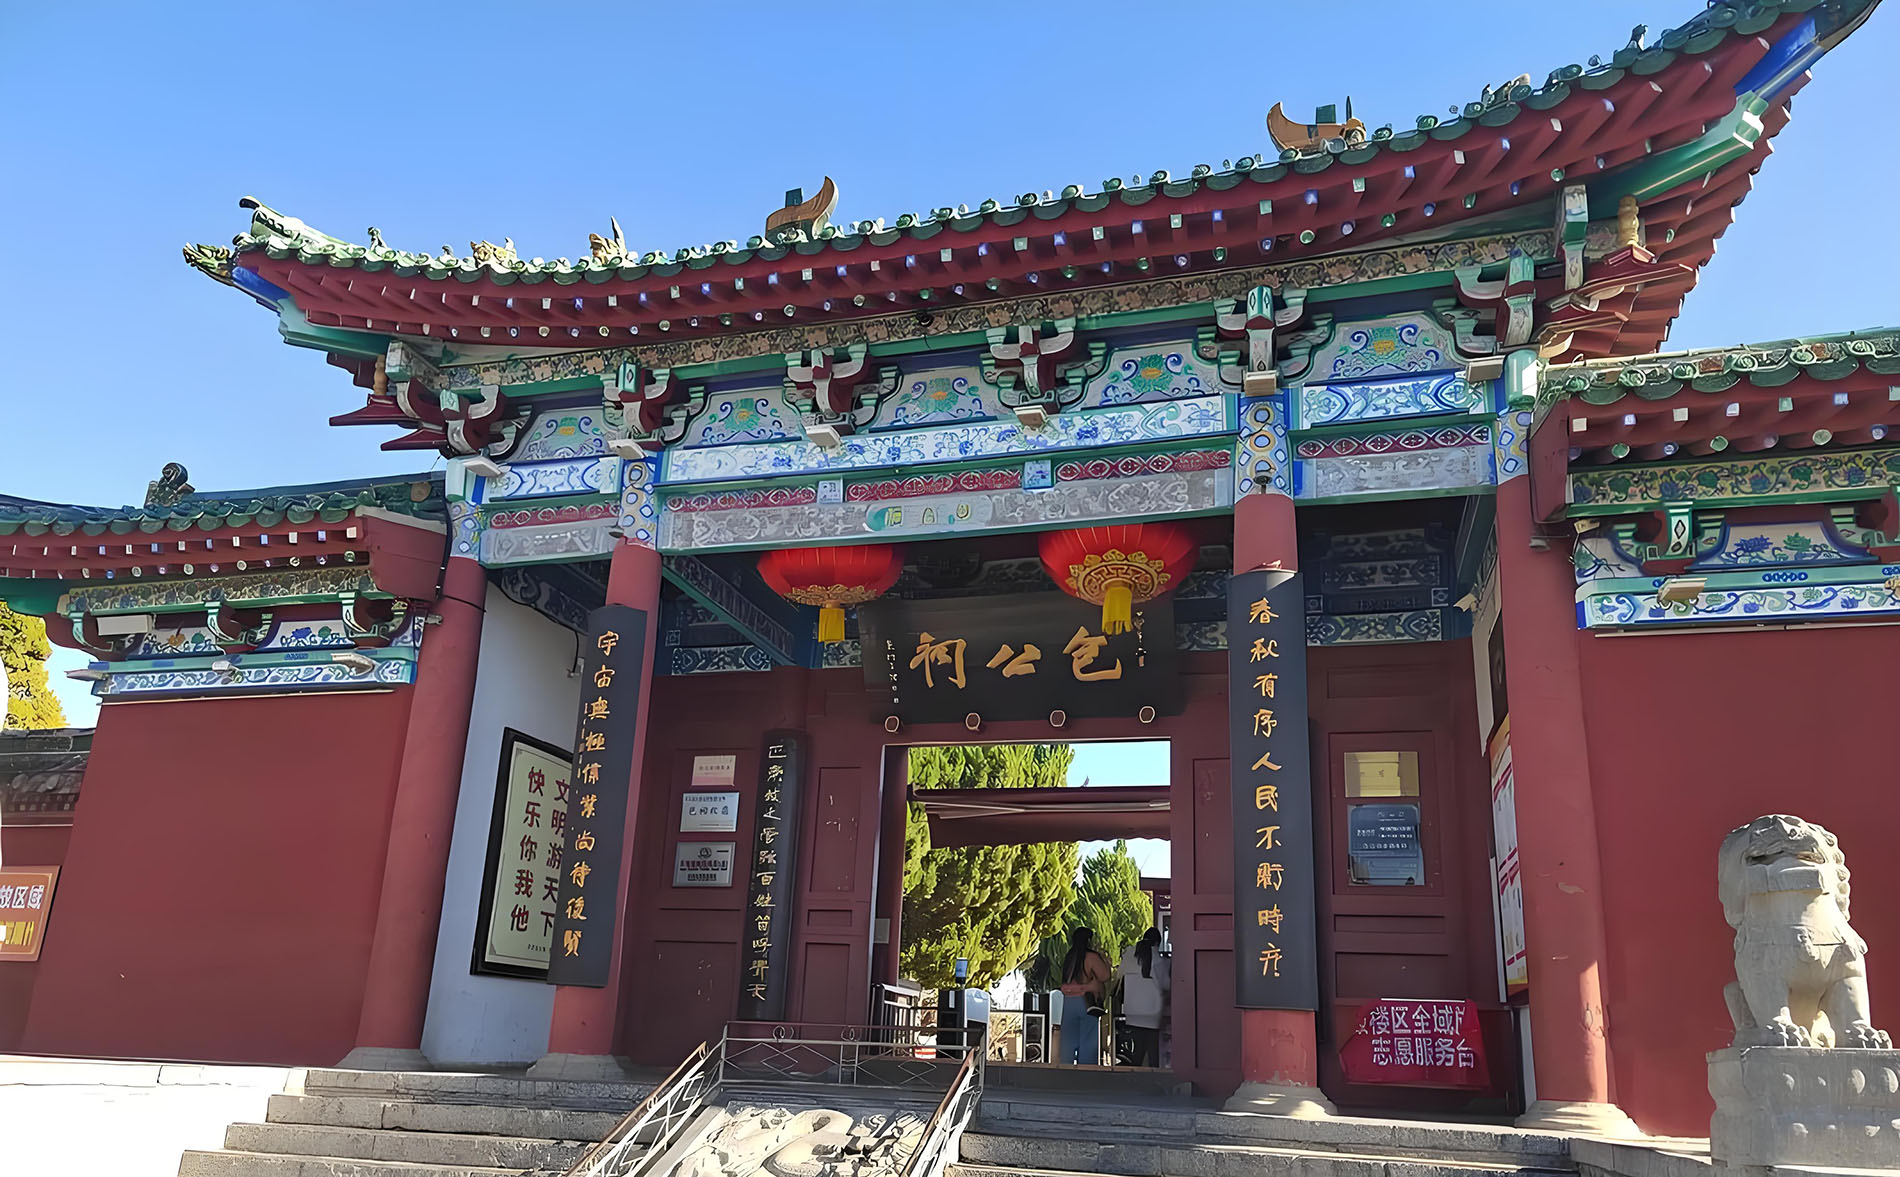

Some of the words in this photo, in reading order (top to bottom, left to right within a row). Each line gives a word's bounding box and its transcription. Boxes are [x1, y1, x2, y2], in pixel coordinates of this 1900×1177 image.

[510, 766, 545, 932] 快乐你我他
[1371, 1036, 1475, 1068] 志愿服务台
